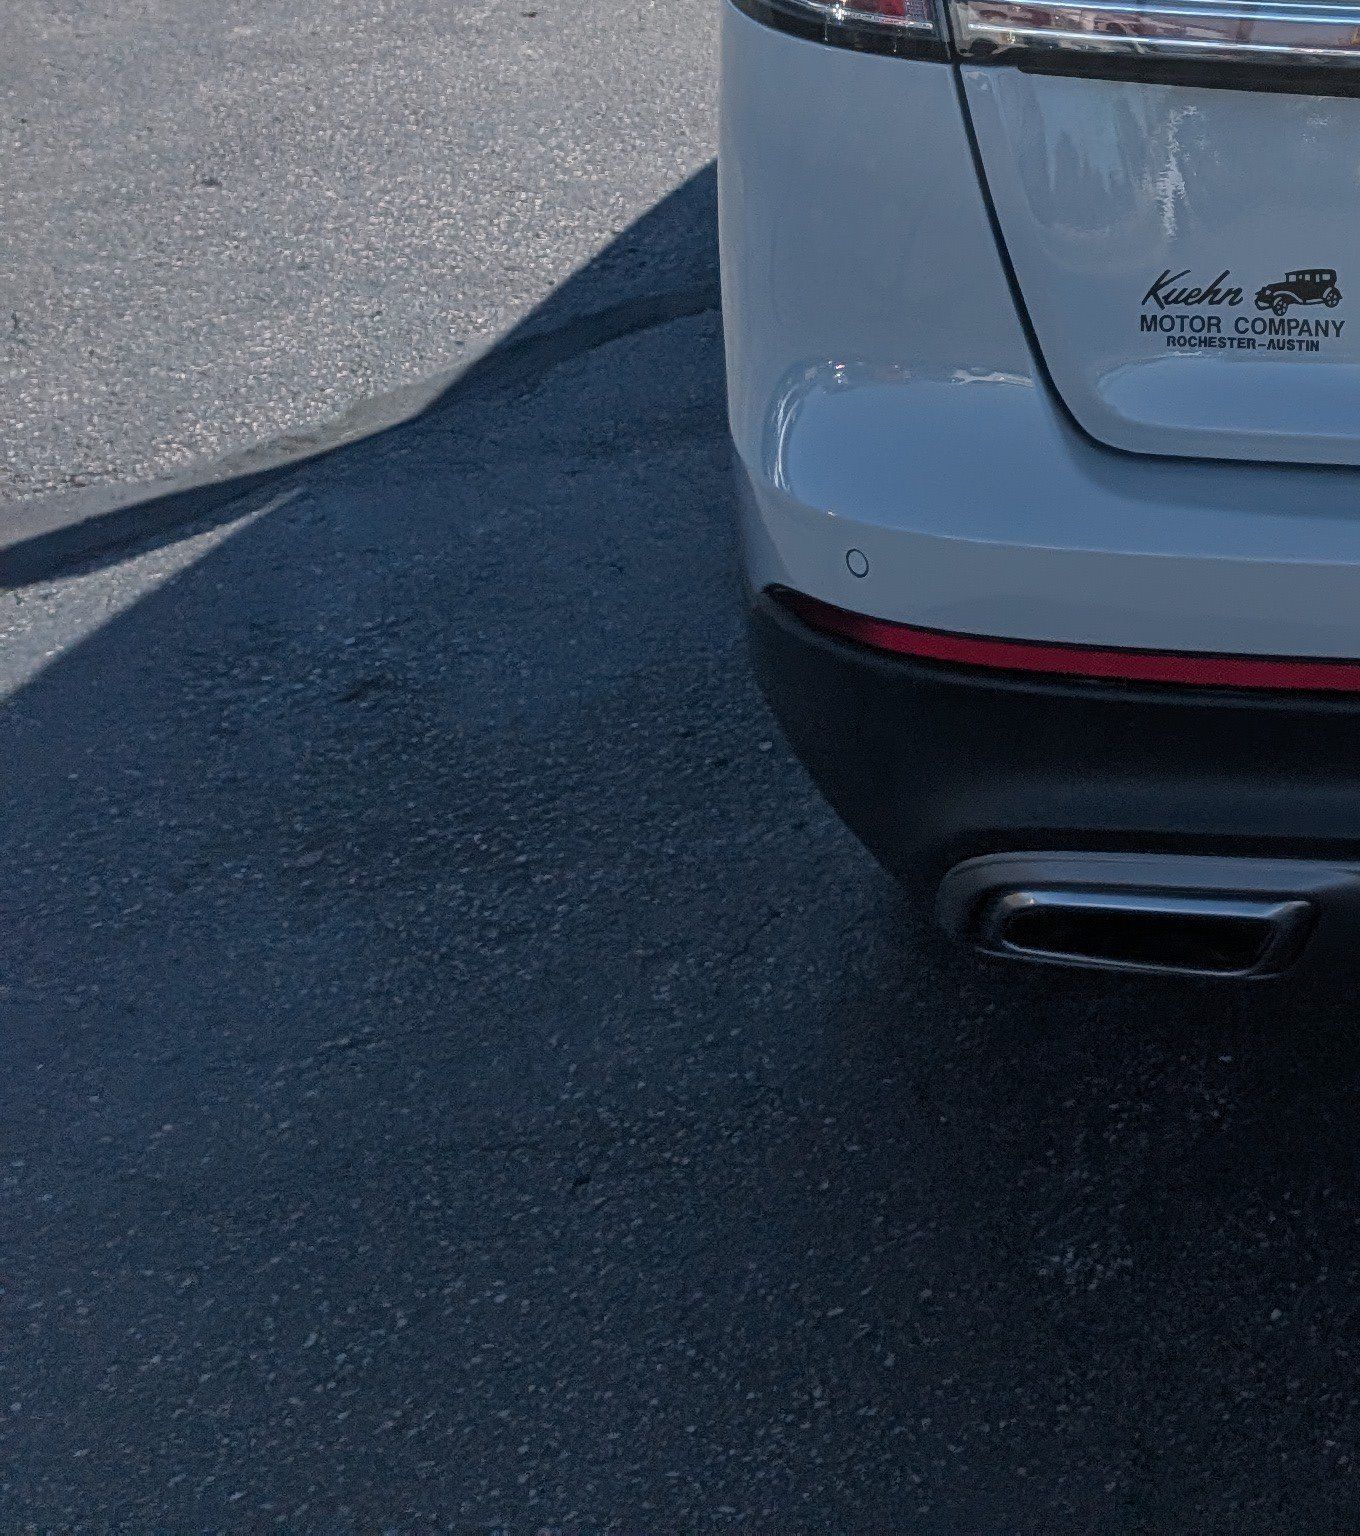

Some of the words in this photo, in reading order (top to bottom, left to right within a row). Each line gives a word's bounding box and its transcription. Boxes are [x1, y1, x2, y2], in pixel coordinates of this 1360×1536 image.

[1141, 269, 1244, 311] Kuehn
[1140, 314, 1222, 334] MOTOR
[1234, 316, 1346, 338] COMPANY
